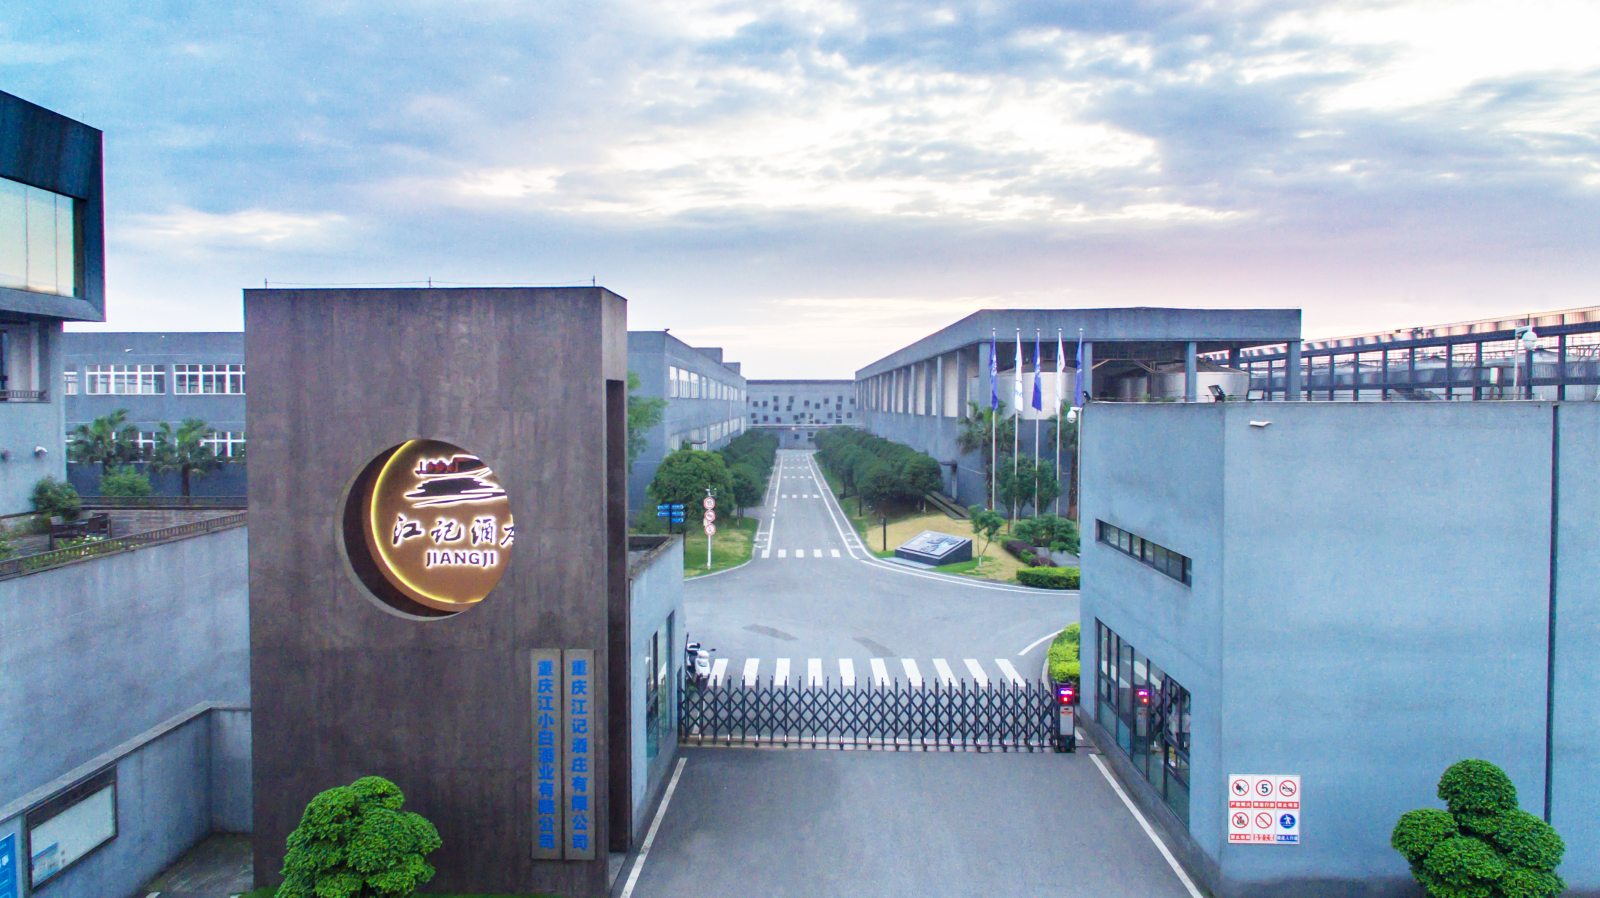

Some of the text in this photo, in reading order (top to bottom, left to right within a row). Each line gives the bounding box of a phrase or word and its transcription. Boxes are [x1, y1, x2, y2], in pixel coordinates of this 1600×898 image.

[425, 551, 495, 568] JIANGJI
[571, 660, 589, 850] 重庆江记酒庄有限公司
[1261, 783, 1269, 794] 5
